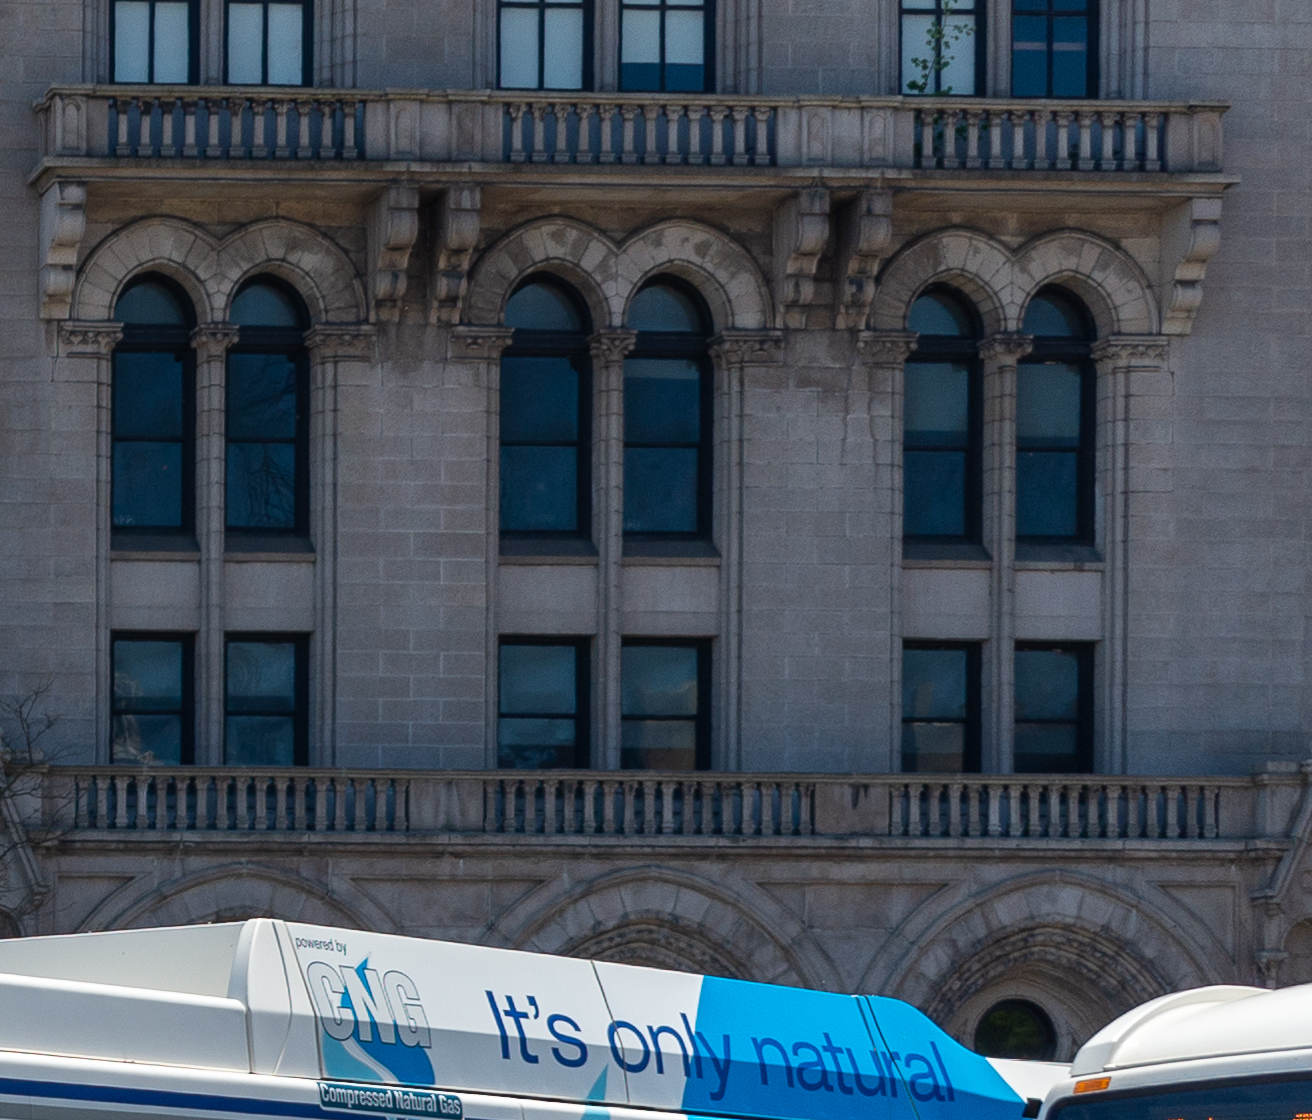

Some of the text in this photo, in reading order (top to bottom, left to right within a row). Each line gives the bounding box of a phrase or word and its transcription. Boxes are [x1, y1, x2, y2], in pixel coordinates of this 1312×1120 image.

[295, 937, 347, 956] powered by
[307, 961, 432, 1049] CNG
[484, 989, 956, 1103] It's only natural
[320, 1082, 462, 1115] Compressed Natural Gas
